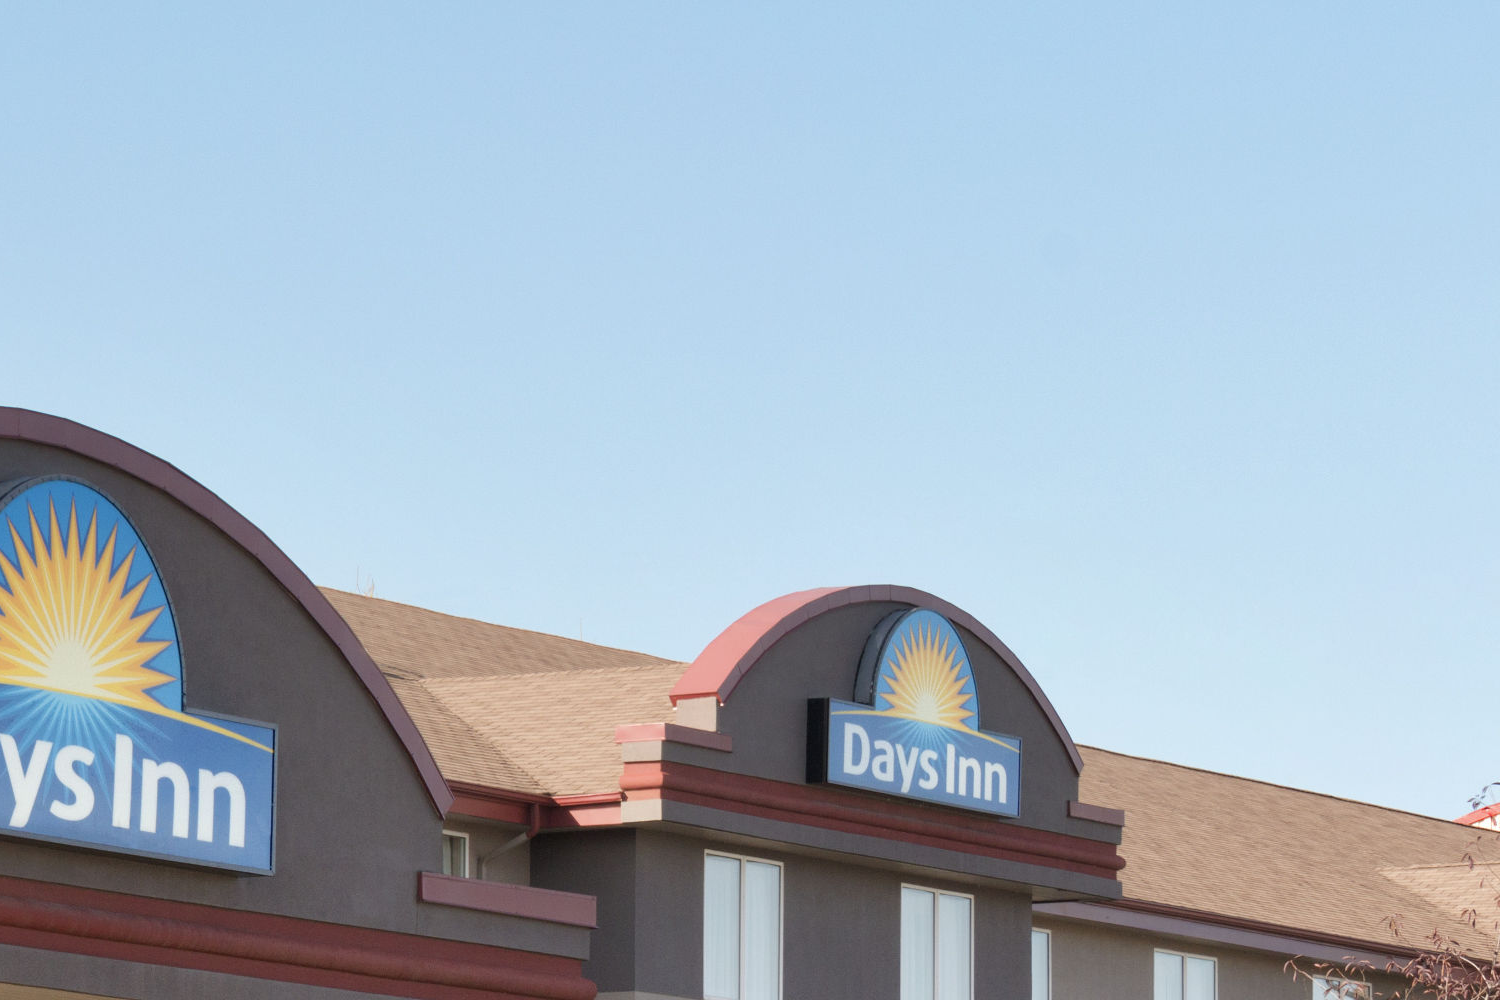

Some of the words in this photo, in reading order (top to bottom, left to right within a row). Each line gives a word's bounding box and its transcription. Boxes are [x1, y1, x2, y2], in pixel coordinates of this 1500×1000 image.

[111, 733, 246, 848] Inn
[843, 722, 939, 793] Days
[945, 743, 1008, 804] Inn
